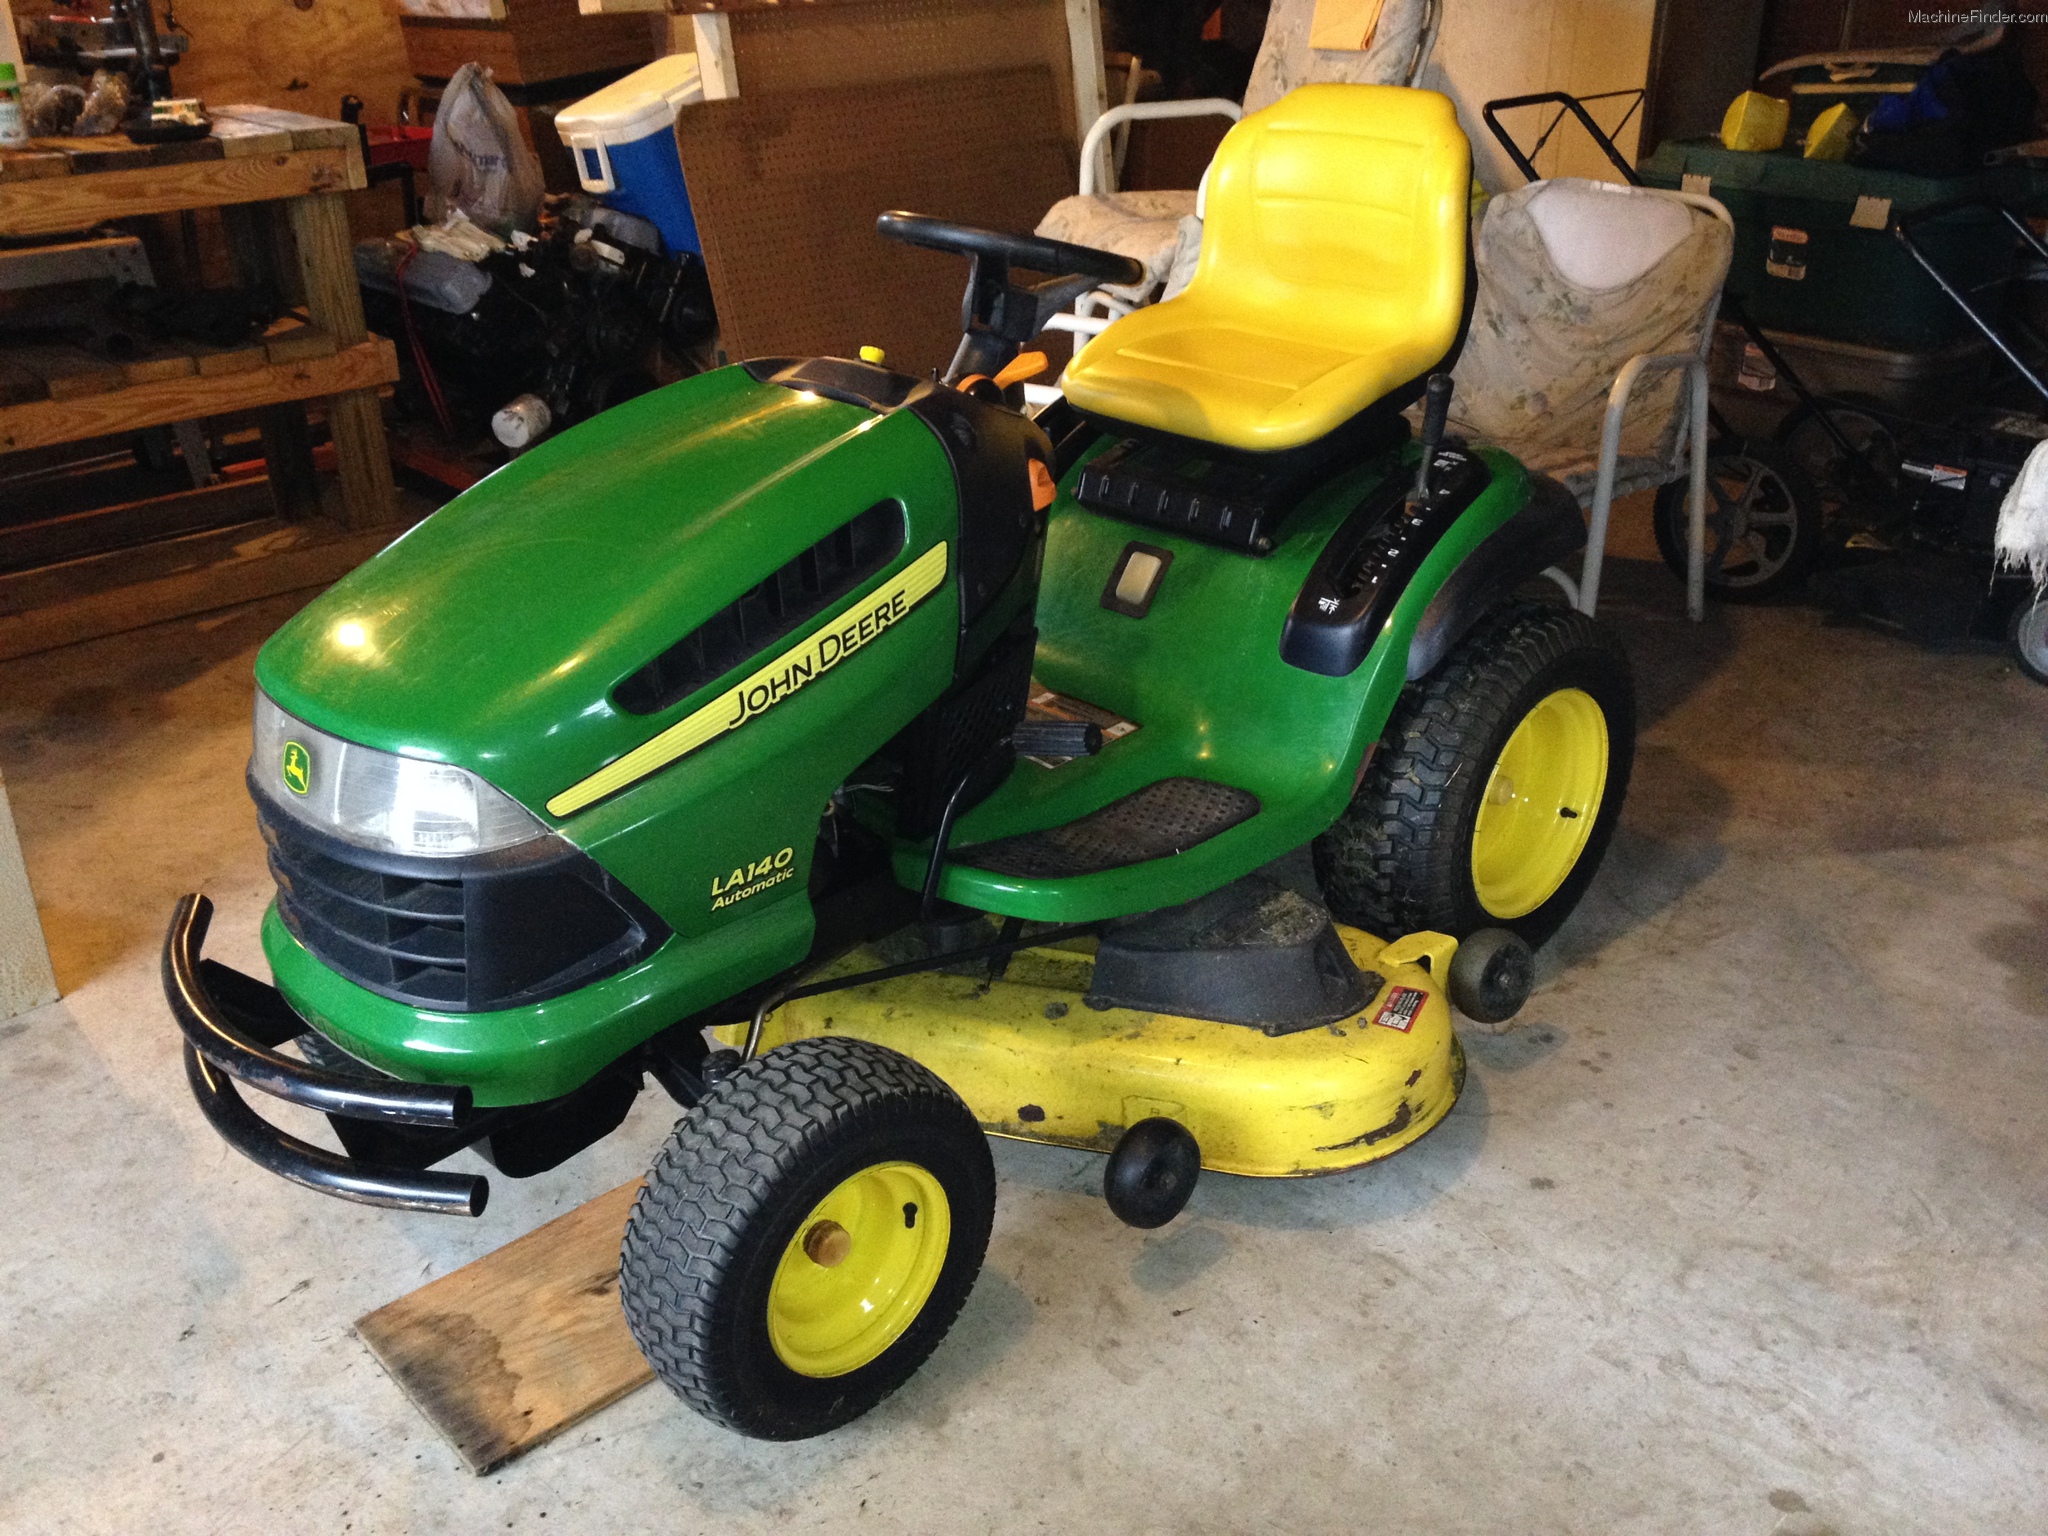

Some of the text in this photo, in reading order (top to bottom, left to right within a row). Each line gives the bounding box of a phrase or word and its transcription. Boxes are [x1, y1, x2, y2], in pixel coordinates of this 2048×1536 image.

[729, 589, 908, 727] JOHN DEERE
[711, 847, 794, 896] LA140
[711, 868, 794, 911] Automatic
